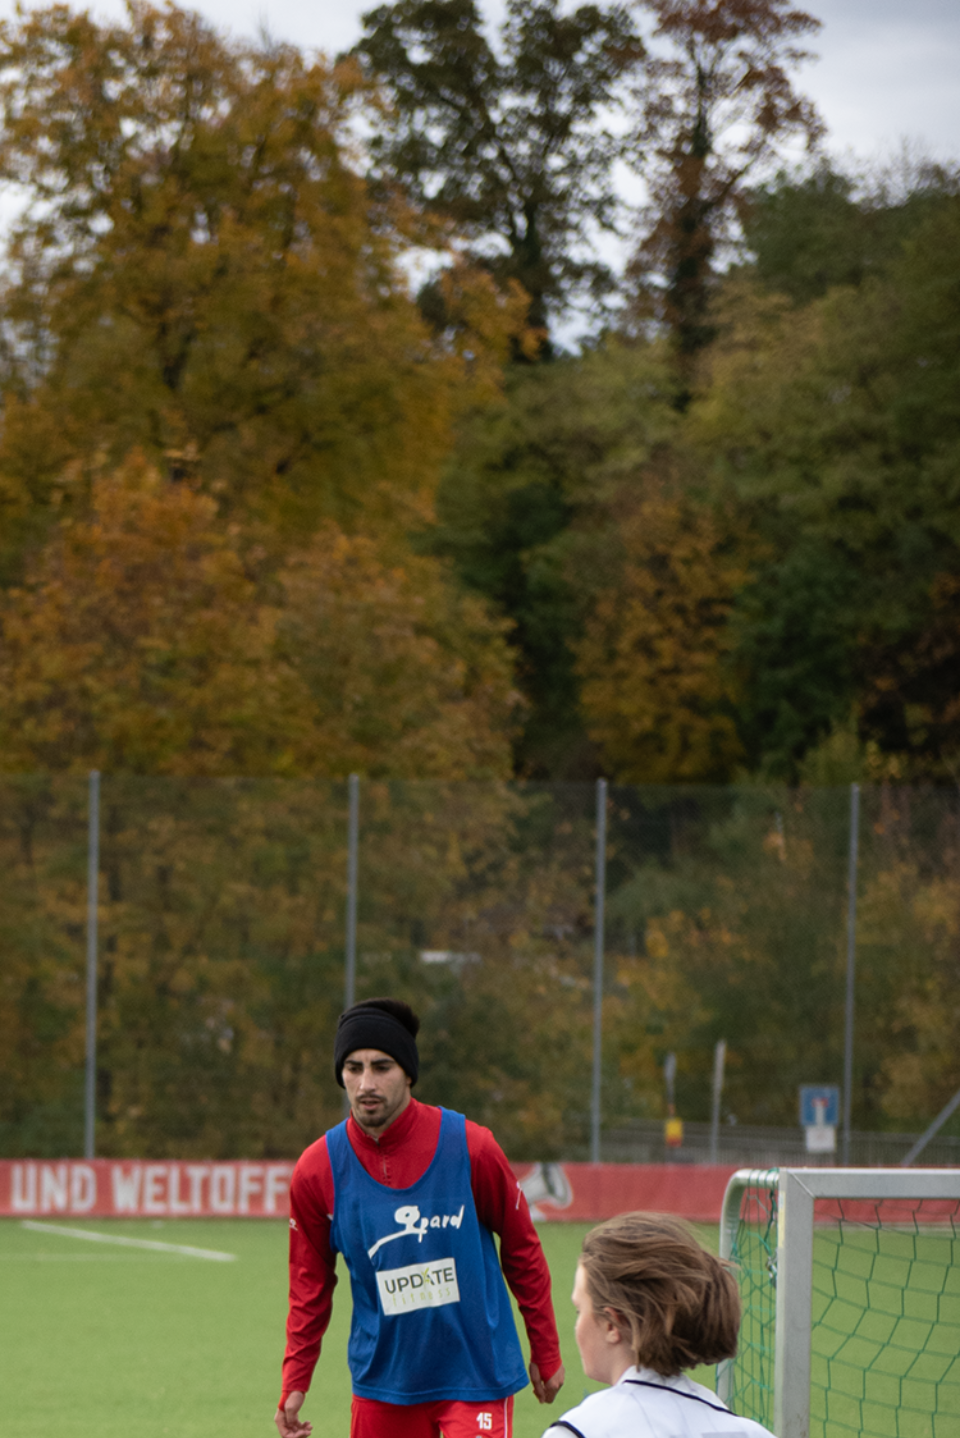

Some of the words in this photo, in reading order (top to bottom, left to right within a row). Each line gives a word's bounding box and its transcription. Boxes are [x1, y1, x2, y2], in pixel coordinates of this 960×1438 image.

[10, 1163, 98, 1213] UND
[111, 1164, 293, 1214] WELTOFF
[384, 1267, 455, 1294] UPDATE
[392, 1288, 452, 1307] fitness
[476, 1412, 492, 1430] 15
